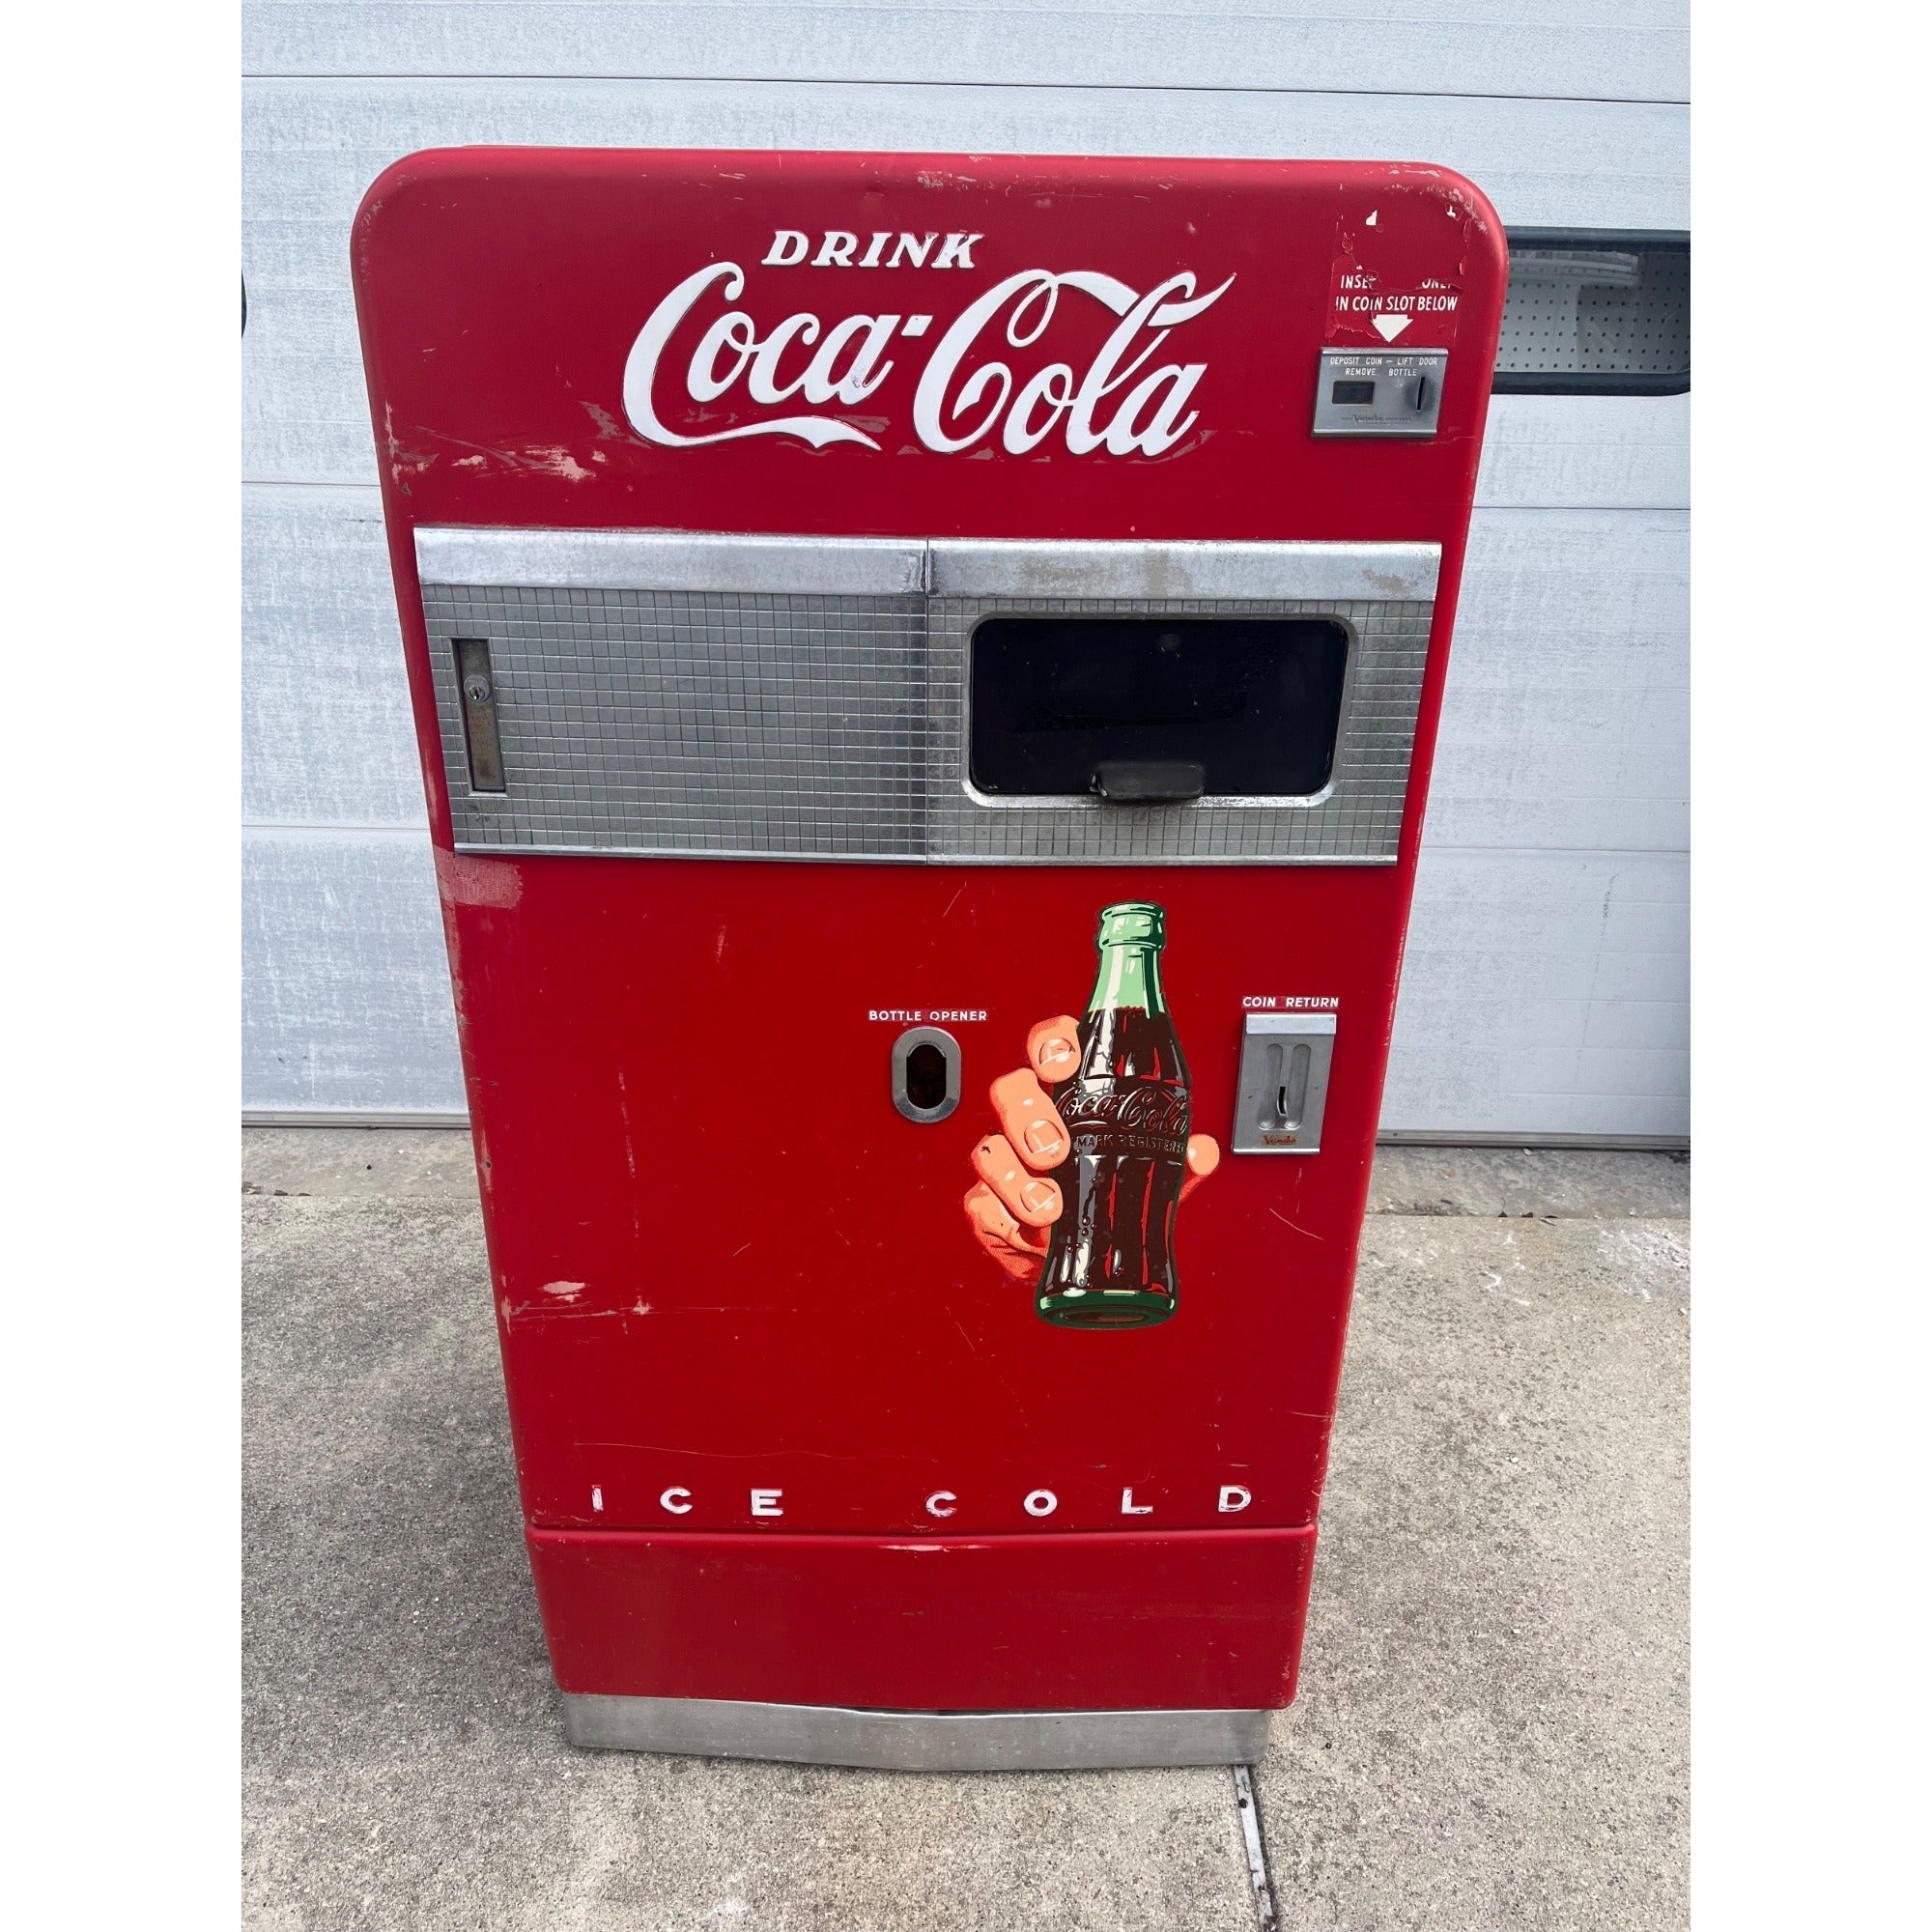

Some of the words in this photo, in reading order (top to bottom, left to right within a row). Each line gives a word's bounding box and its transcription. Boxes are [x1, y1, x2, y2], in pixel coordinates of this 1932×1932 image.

[762, 230, 983, 268] DRINK
[1340, 274, 1376, 289] INSE
[1335, 296, 1349, 311] IN
[1352, 296, 1382, 311] COIN
[1386, 296, 1415, 311] SLOT
[1417, 296, 1458, 311] BELOW
[623, 261, 1236, 457] Coca-Cola
[1329, 356, 1360, 365] DEPOSIT
[1365, 356, 1382, 365] COIN
[1397, 356, 1413, 365] LIFT
[1419, 356, 1438, 365] DOOR
[1345, 367, 1377, 376] REMOVE
[1388, 368, 1417, 377] BOTTLE
[1242, 996, 1276, 1008] COIN
[1286, 997, 1339, 1008] RETURN
[868, 1009, 923, 1021] BOTTLE
[929, 1010, 987, 1021] OPENER
[1077, 1134, 1114, 1148] MARK
[592, 1486, 783, 1517] ICE
[925, 1485, 1252, 1519] COLD
